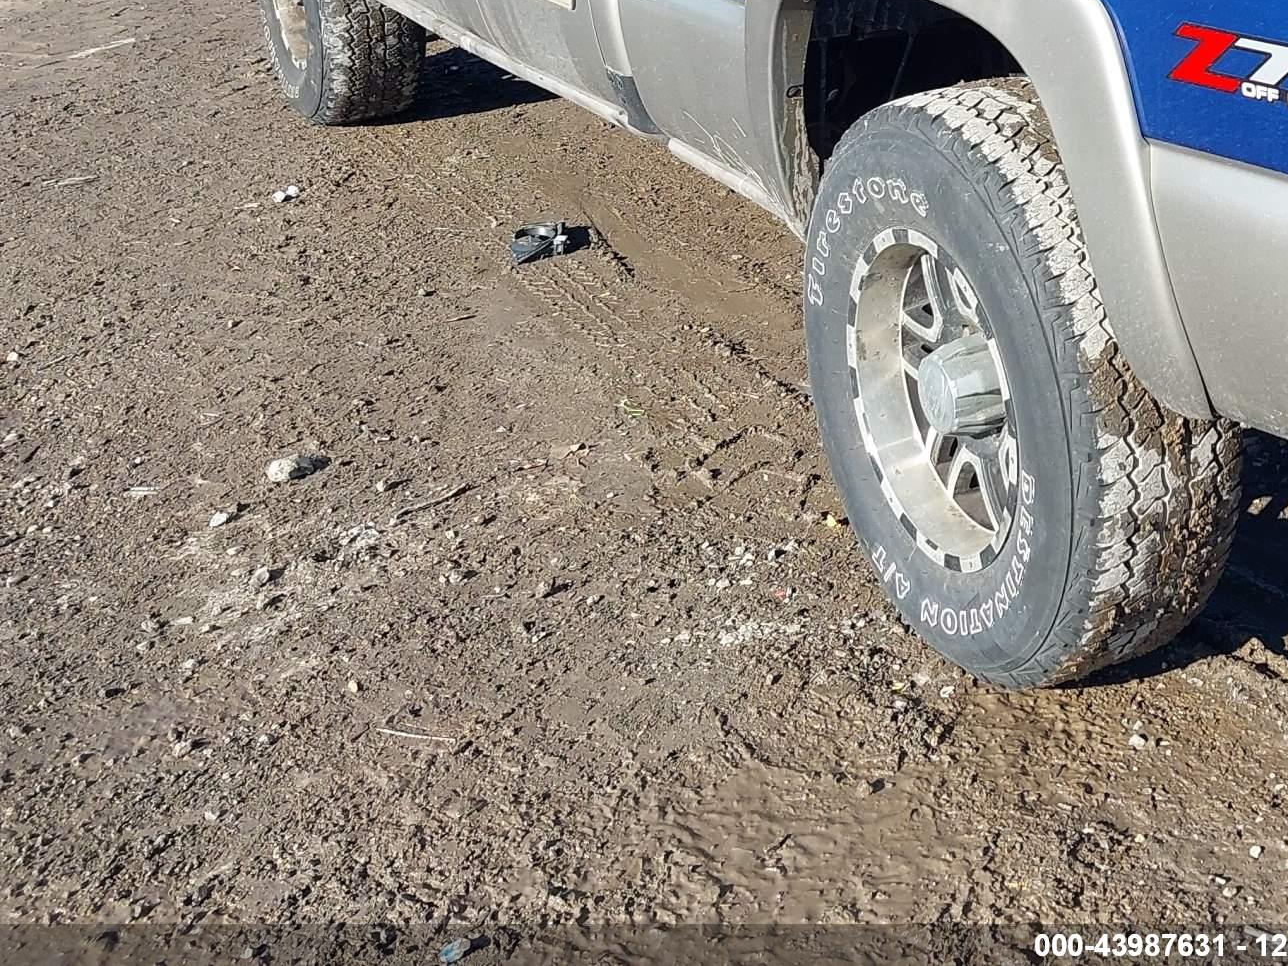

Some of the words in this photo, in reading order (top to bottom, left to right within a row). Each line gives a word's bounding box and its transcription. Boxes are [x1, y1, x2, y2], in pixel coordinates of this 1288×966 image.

[1240, 81, 1280, 103] OFF
[807, 176, 930, 307] Firestone
[871, 540, 913, 600] A/T
[920, 469, 1035, 637] DESTINATION
